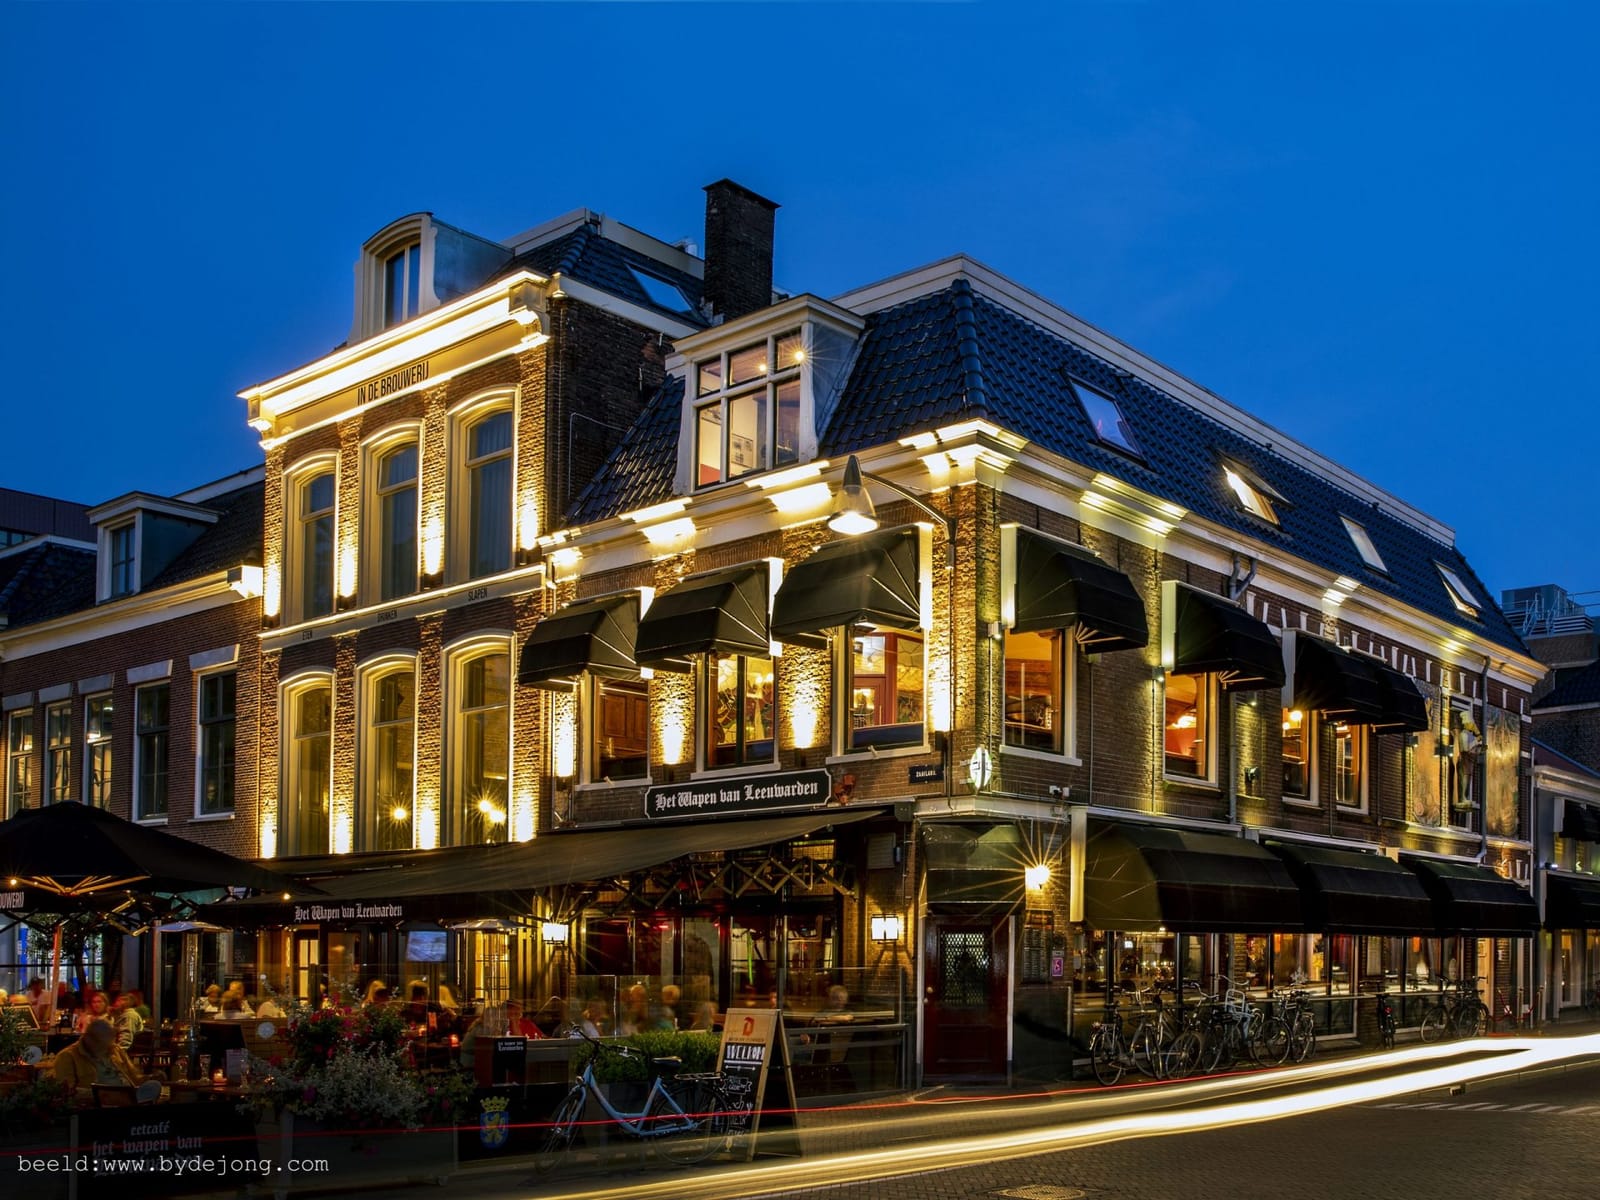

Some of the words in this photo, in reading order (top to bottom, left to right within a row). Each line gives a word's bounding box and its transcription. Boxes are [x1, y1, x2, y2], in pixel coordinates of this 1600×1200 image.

[357, 386, 366, 406] IN
[368, 381, 379, 401] DE
[380, 360, 429, 397] BROUWERIJ
[468, 587, 488, 602] SLAPEN
[655, 792, 677, 812] Het
[677, 790, 717, 809] Wapen
[719, 788, 741, 803] van
[744, 780, 819, 801] Leeuwarden
[294, 905, 310, 924] Het
[310, 904, 340, 922] Wapen
[341, 904, 355, 919] van
[355, 902, 403, 919] Leeuwarden
[129, 1119, 171, 1137] eetcafé
[121, 1138, 169, 1156] wapen
[176, 1135, 203, 1150] van
